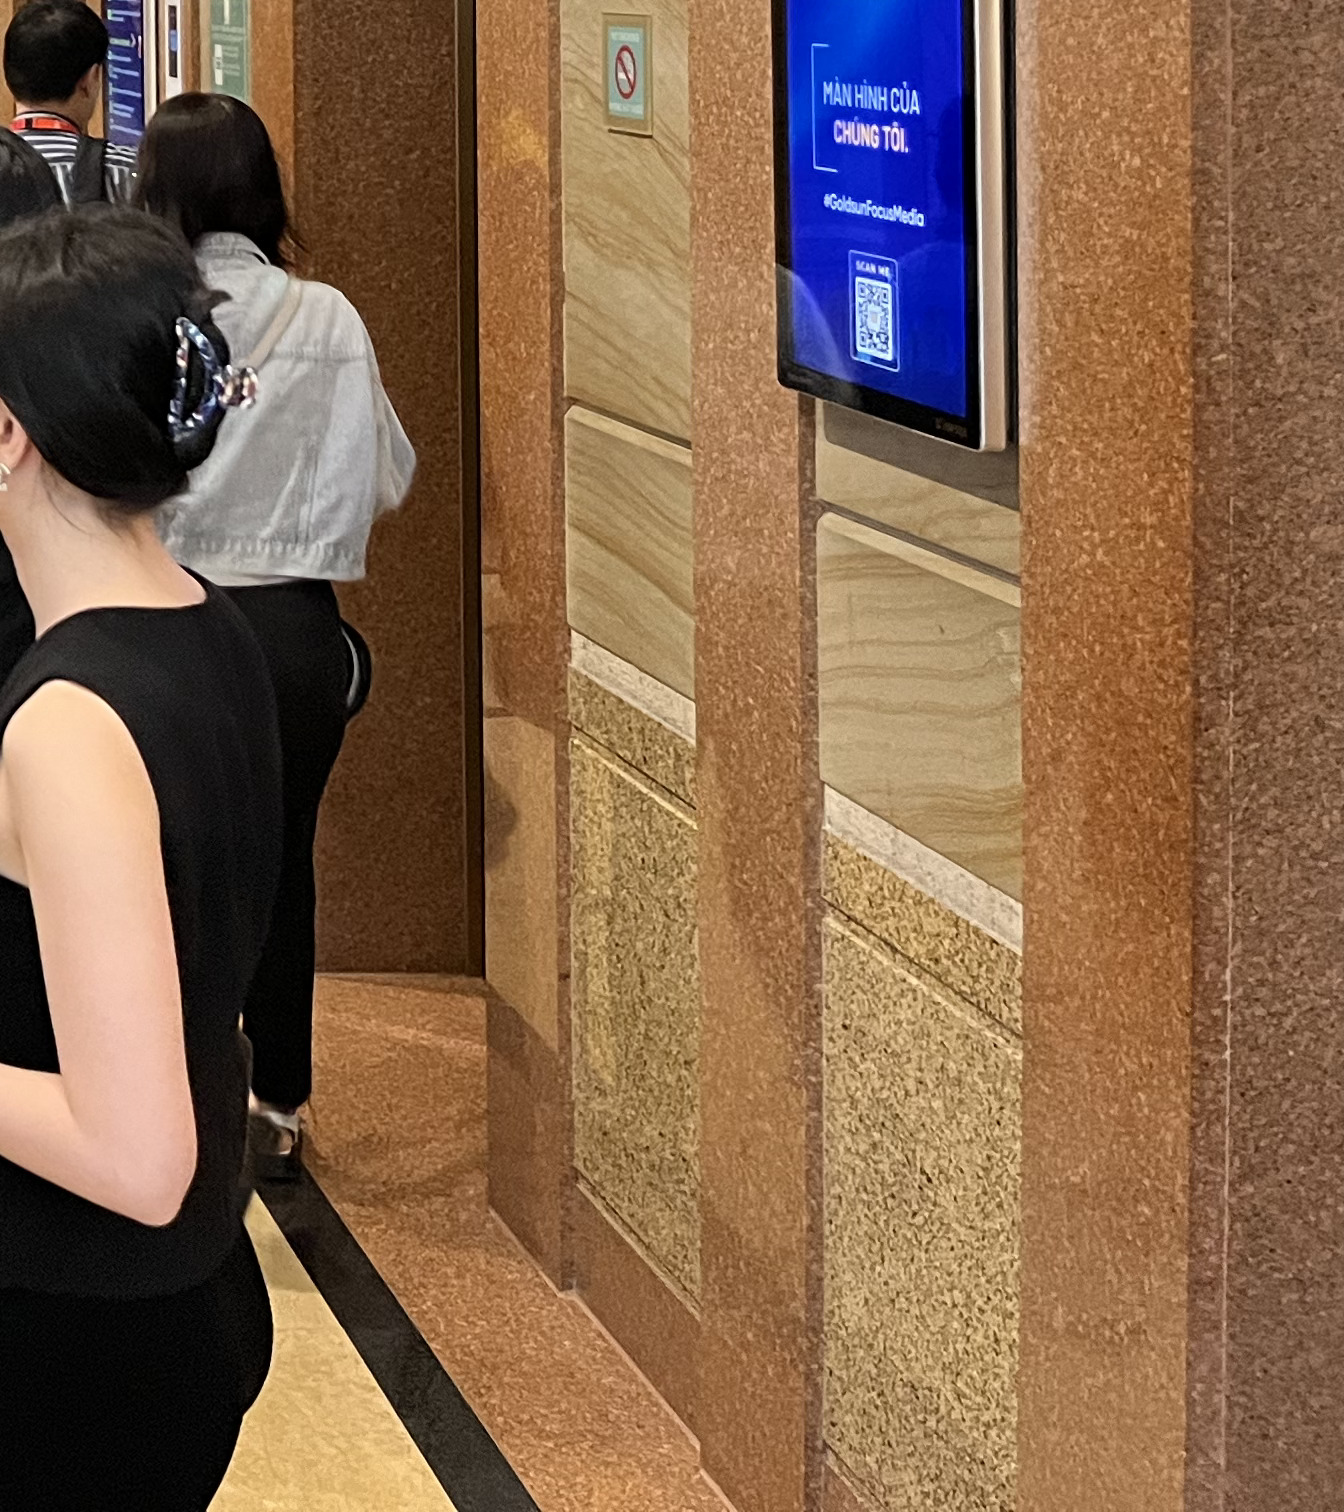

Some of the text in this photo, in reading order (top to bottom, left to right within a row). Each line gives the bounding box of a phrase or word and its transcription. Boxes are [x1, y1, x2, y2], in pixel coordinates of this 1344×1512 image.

[823, 75, 921, 115] MÀN HÌNH CỦA
[833, 116, 879, 149] CHÚNG
[823, 193, 925, 227] #GoldsunFocusMedia
